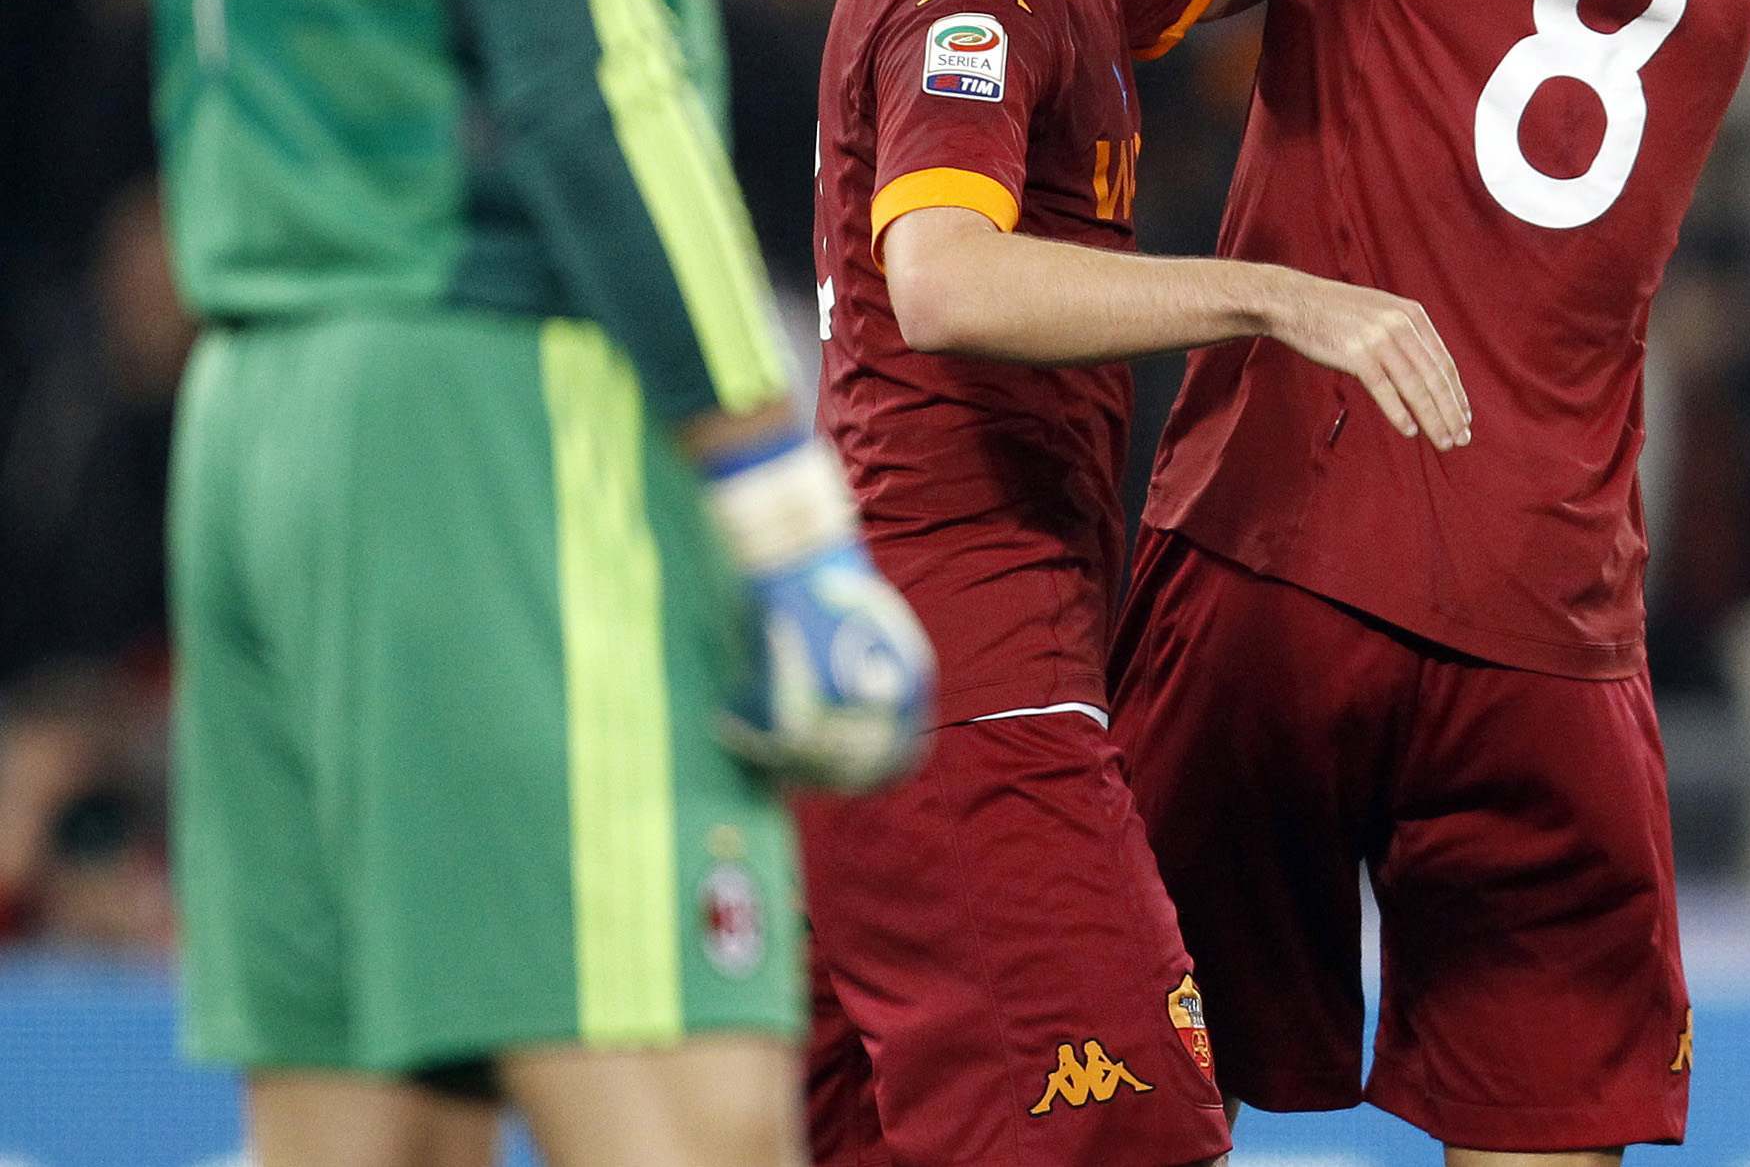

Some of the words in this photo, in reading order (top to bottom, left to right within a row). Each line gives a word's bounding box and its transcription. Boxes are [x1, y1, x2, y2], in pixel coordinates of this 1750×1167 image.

[938, 54, 978, 68] SERIE
[980, 58, 992, 71] A
[961, 77, 994, 96] TIM
